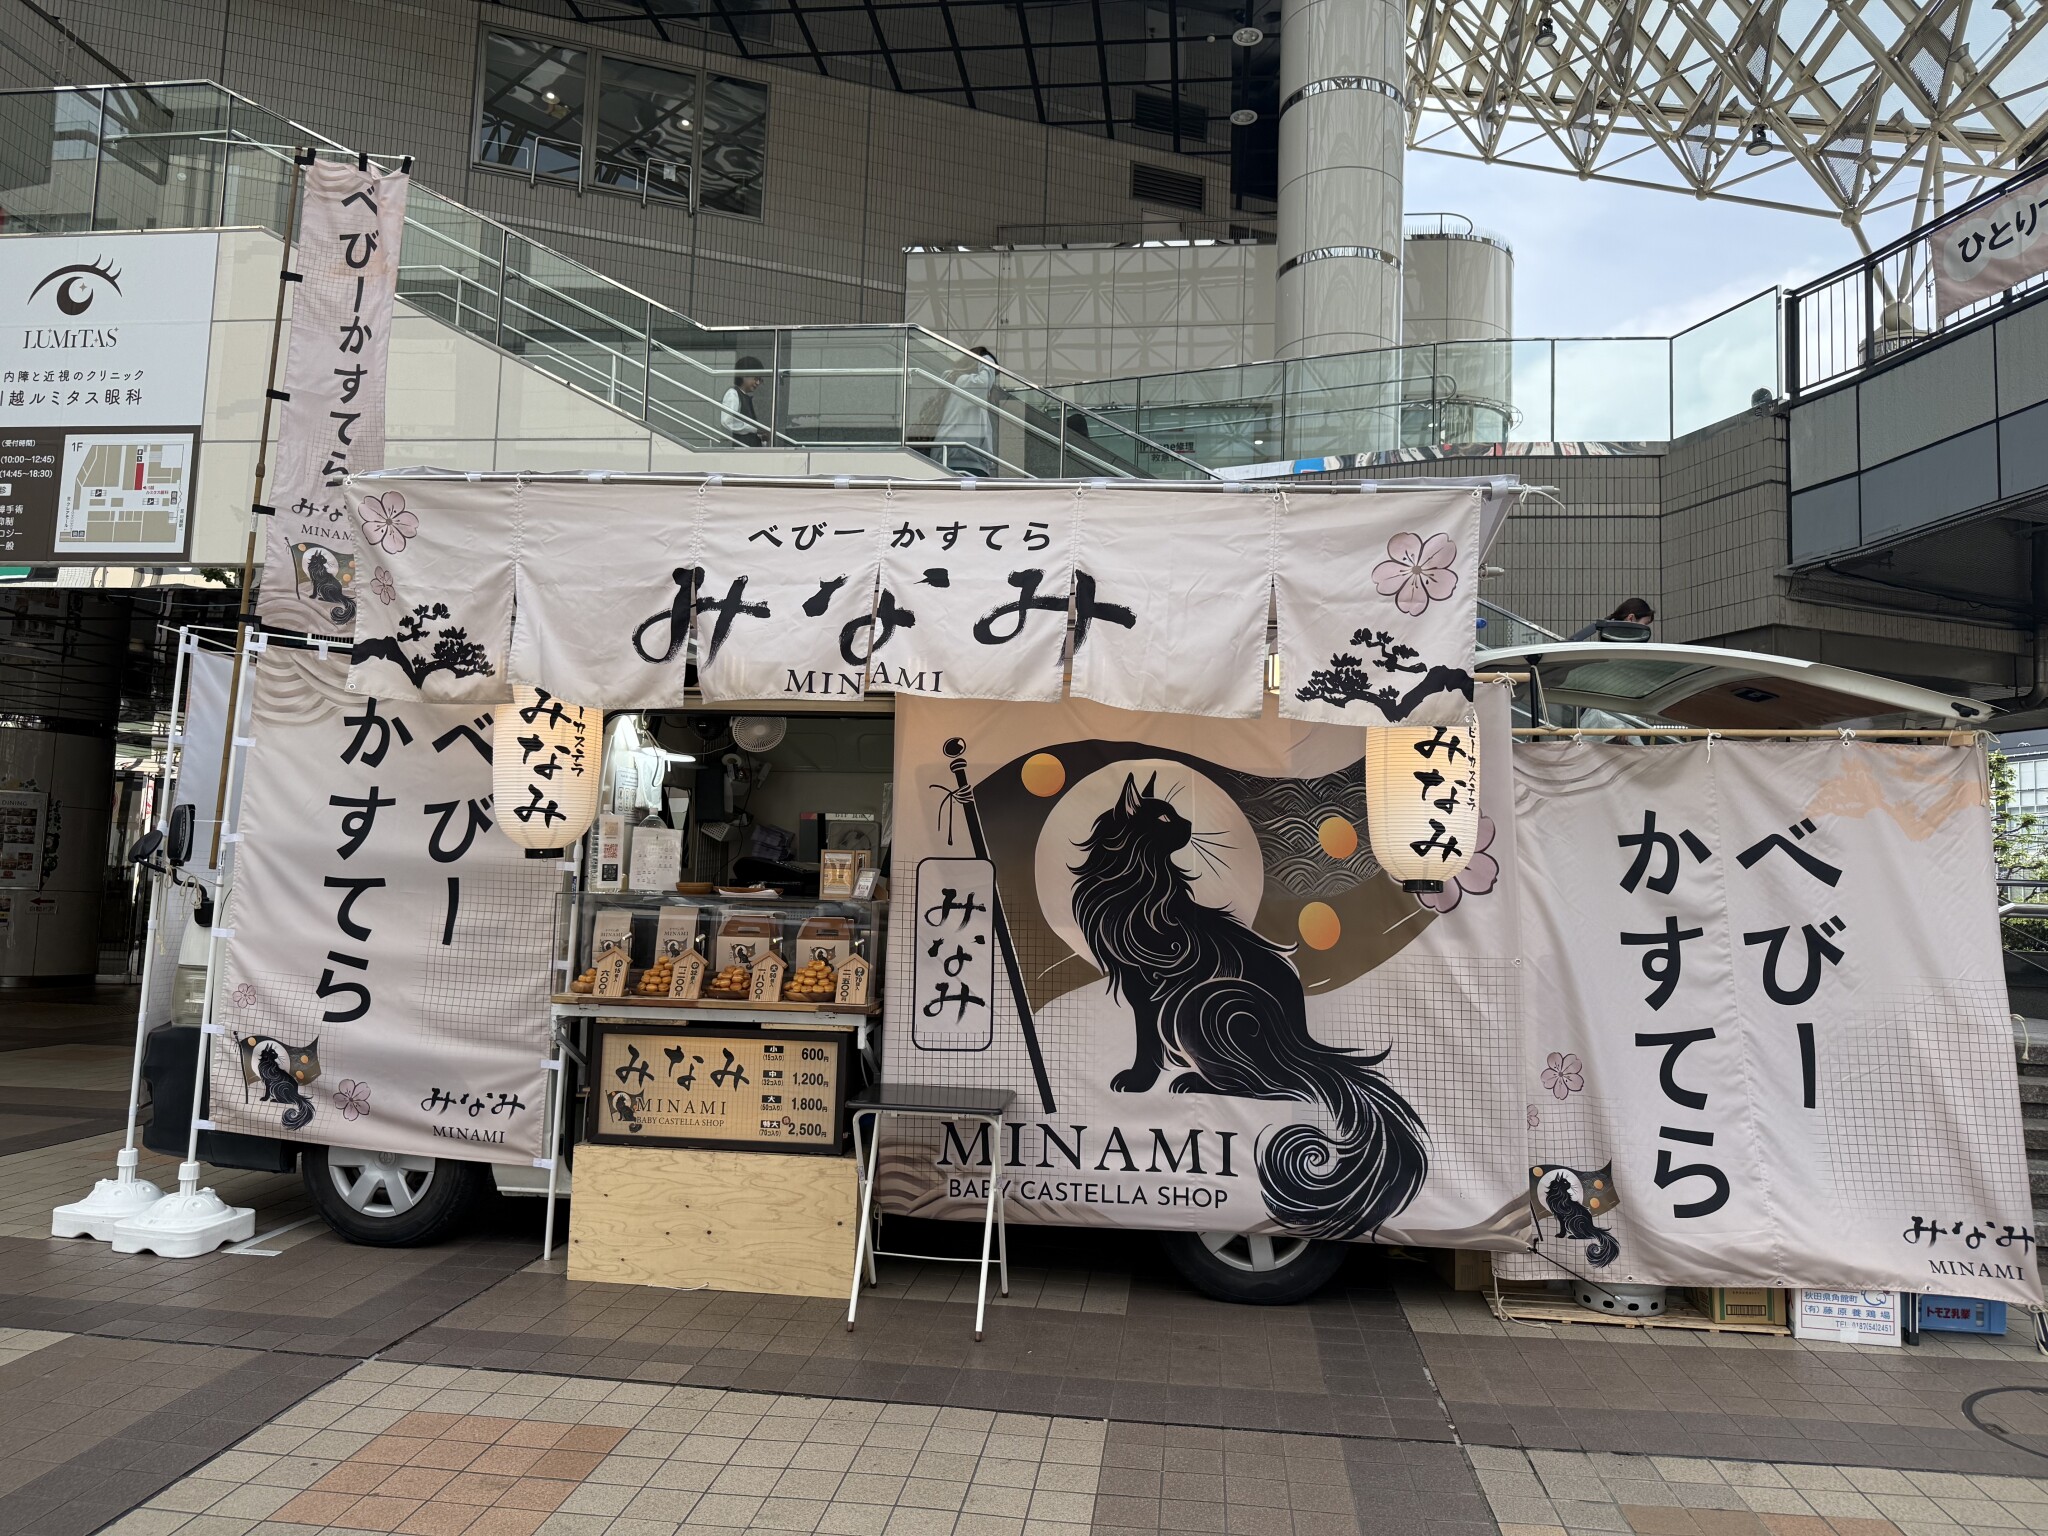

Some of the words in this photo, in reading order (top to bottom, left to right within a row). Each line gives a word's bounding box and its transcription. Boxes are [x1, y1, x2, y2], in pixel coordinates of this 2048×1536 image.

[71, 442, 83, 452] 1F
[748, 521, 865, 551] べびー
[891, 521, 1052, 551] かすてら
[631, 565, 1137, 670] みなみ
[783, 662, 944, 695] MINAMI
[513, 686, 572, 829] みなみ
[1409, 726, 1467, 863] みなみ
[423, 712, 494, 946] べびー
[315, 697, 413, 1023] かすてら
[922, 888, 987, 1025] みなみ
[1735, 817, 1847, 1110] べびー
[1616, 809, 1731, 1219] かすてら
[615, 1043, 750, 1092] みなみ
[421, 1087, 526, 1120] みなみ
[636, 1098, 727, 1115] MINAMI
[636, 1116, 657, 1124] BABY
[658, 1117, 700, 1126] CASTELLA
[702, 1118, 725, 1127] SHOP
[432, 1125, 505, 1144] MINAMI
[936, 1121, 1239, 1178] MINAMI
[949, 1178, 1012, 1199] BABY
[1020, 1180, 1149, 1205] CASTELLA
[1156, 1186, 1228, 1209] SHOP
[1902, 1215, 2035, 1256] みなみ
[1928, 1259, 2026, 1281] MINAMI
[1804, 1291, 1858, 1303] 秋田県角館町
